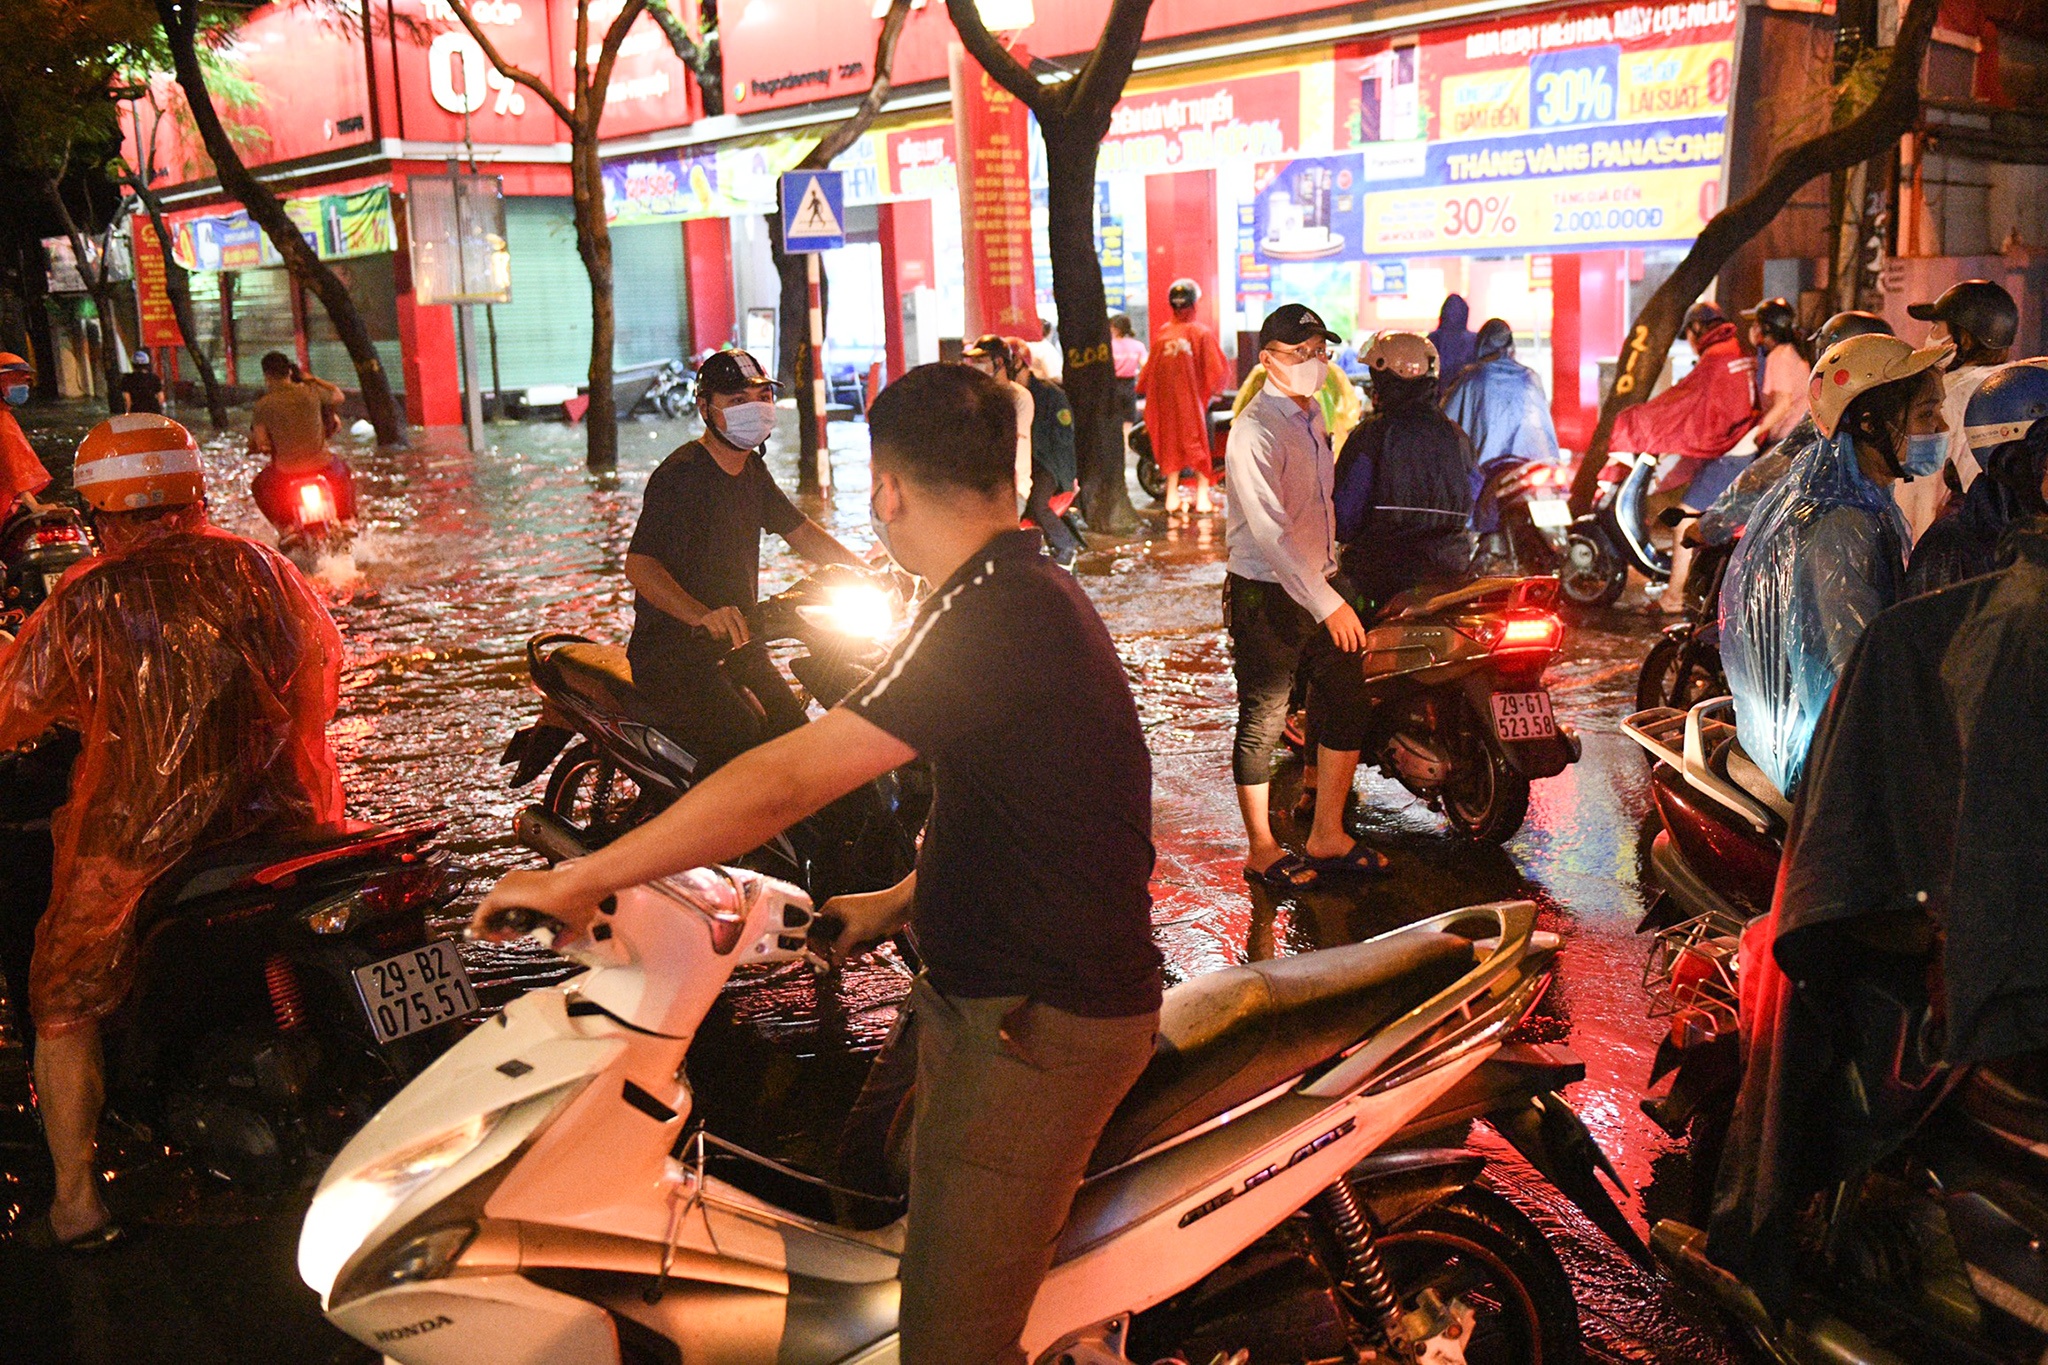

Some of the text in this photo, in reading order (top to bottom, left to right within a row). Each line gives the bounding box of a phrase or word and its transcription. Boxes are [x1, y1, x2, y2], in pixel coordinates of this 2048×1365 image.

[1536, 66, 1612, 125] 30%
[1446, 145, 1525, 181] THÁNG
[1525, 142, 1589, 174] VÀNG
[1443, 195, 1517, 236] 30%
[1553, 208, 1664, 232] 2.000.000Đ
[1499, 694, 1543, 716] 29-G1
[1499, 716, 1552, 738] 523.58
[372, 947, 451, 999] 29-B2
[377, 979, 472, 1037] 075.51
[375, 1315, 454, 1341] HONDA
